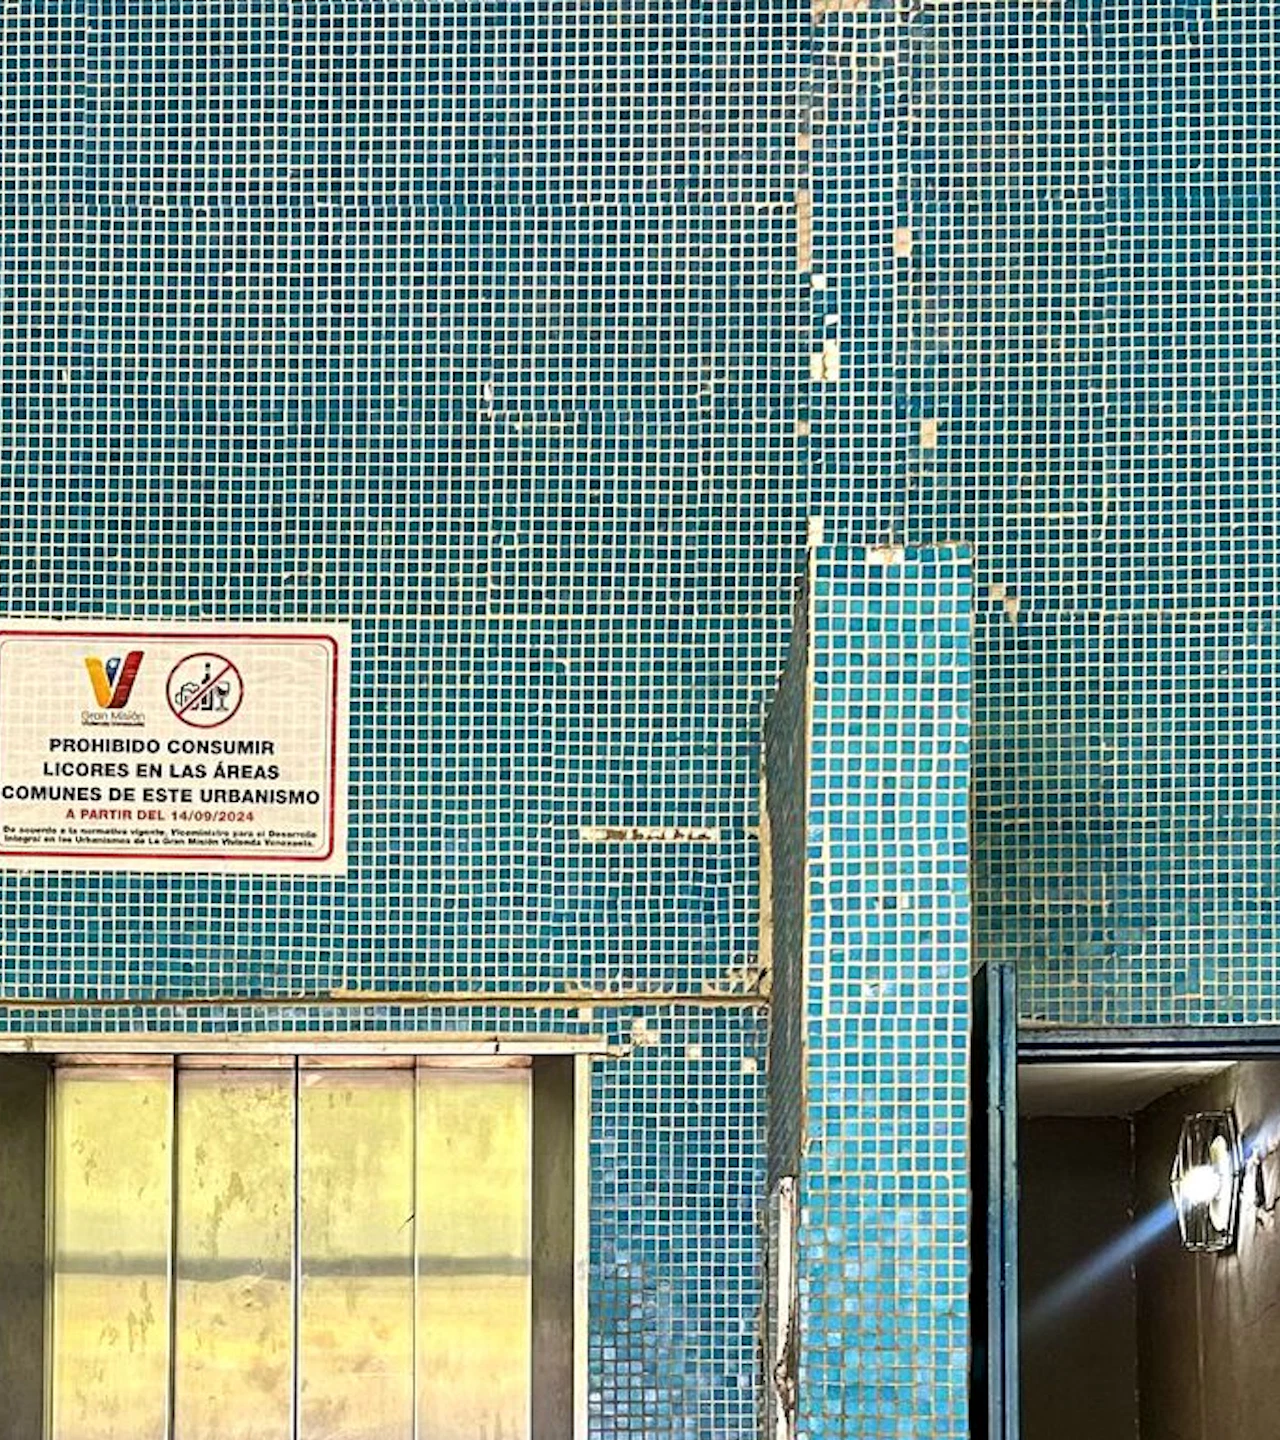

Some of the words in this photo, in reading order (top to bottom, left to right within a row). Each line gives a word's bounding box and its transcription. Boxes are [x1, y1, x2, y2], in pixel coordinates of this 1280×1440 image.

[50, 739, 160, 754] PROHIBIDO
[168, 740, 274, 755] CONSUMIR
[44, 763, 128, 777] LICORES
[136, 764, 162, 778] EN
[170, 764, 206, 778] LAS
[214, 762, 279, 780] ÁREAS
[2, 786, 102, 801] COMUNES
[110, 788, 135, 801] DE
[144, 788, 192, 802] ESTE
[201, 789, 320, 804] URBANISMO
[66, 809, 75, 818] A
[81, 809, 132, 820] PARTIR
[138, 810, 164, 821] DEL
[172, 811, 254, 822] 14/09/2024
